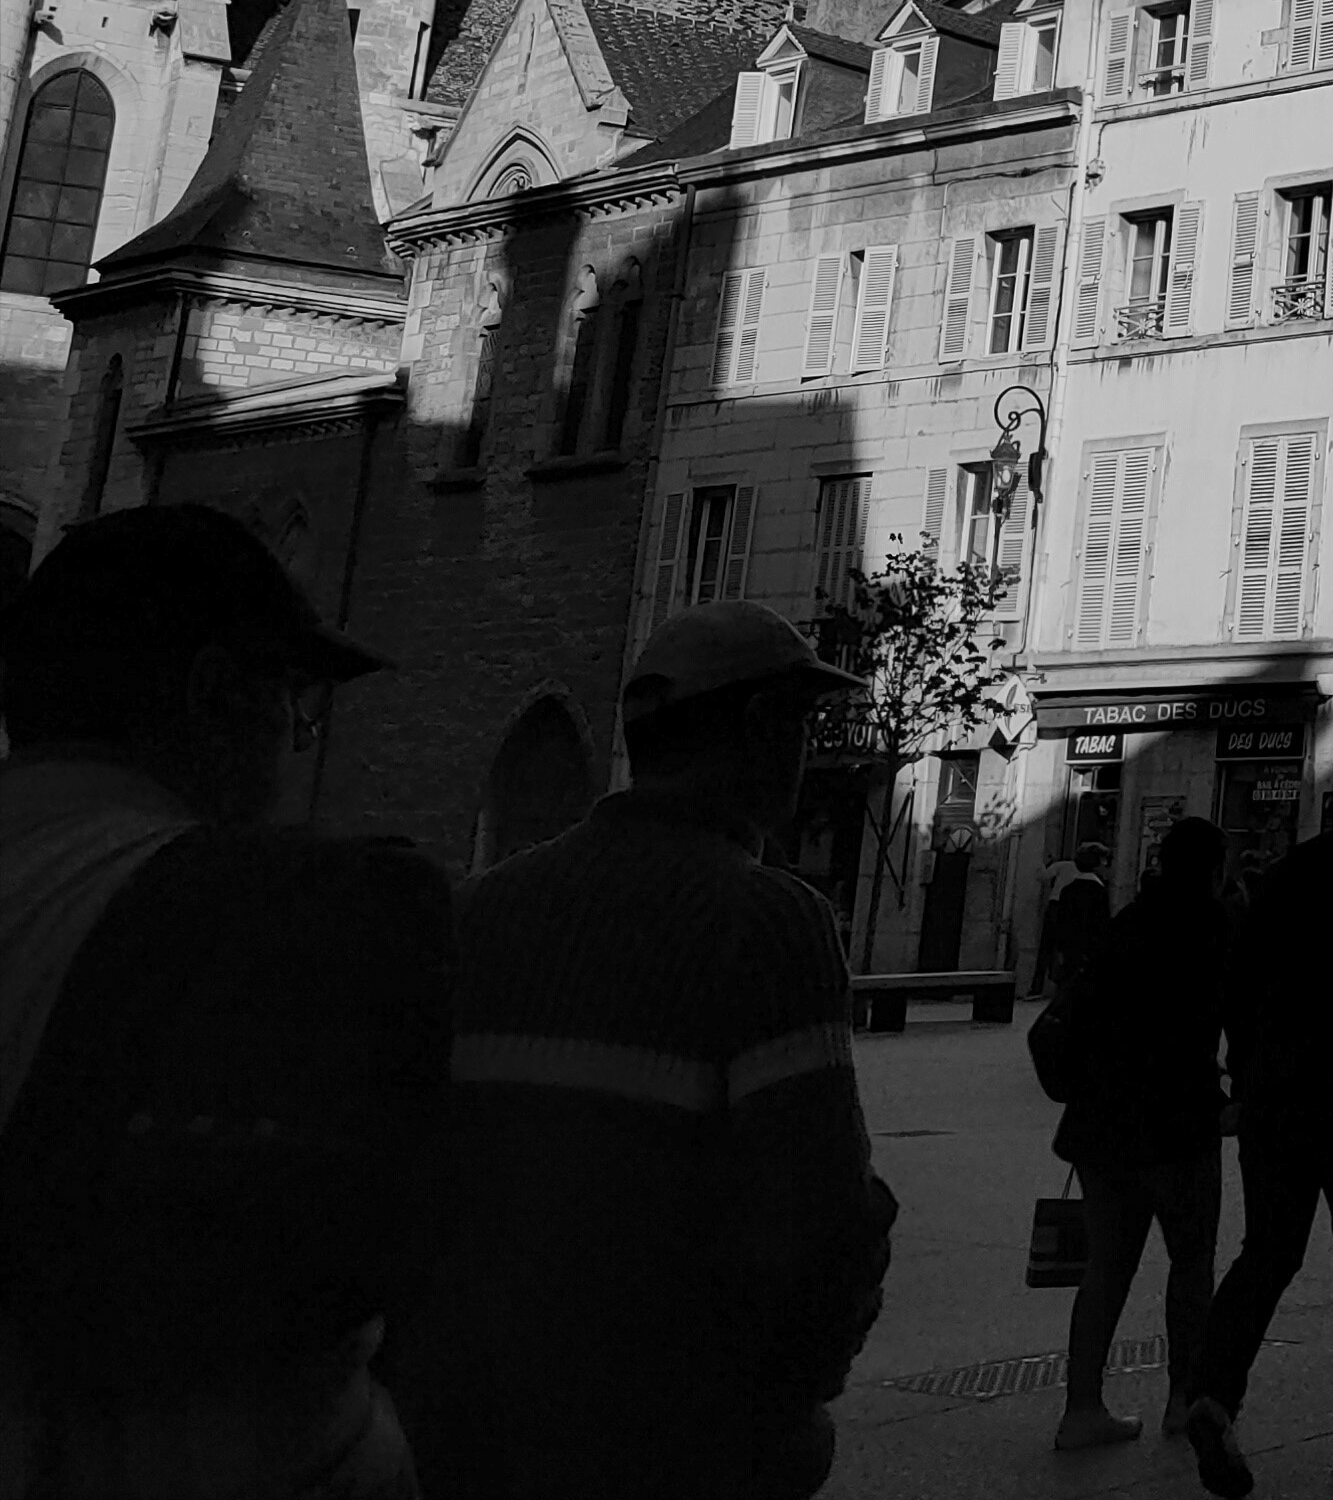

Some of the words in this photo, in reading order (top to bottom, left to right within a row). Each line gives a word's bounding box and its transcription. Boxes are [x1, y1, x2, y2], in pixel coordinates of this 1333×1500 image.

[1083, 704, 1147, 724] TABAC
[1157, 702, 1198, 720] DES
[1209, 698, 1266, 719] DUCS
[1074, 734, 1117, 755] TABAC
[1227, 732, 1253, 751] DES
[1258, 731, 1293, 750] DUCS
